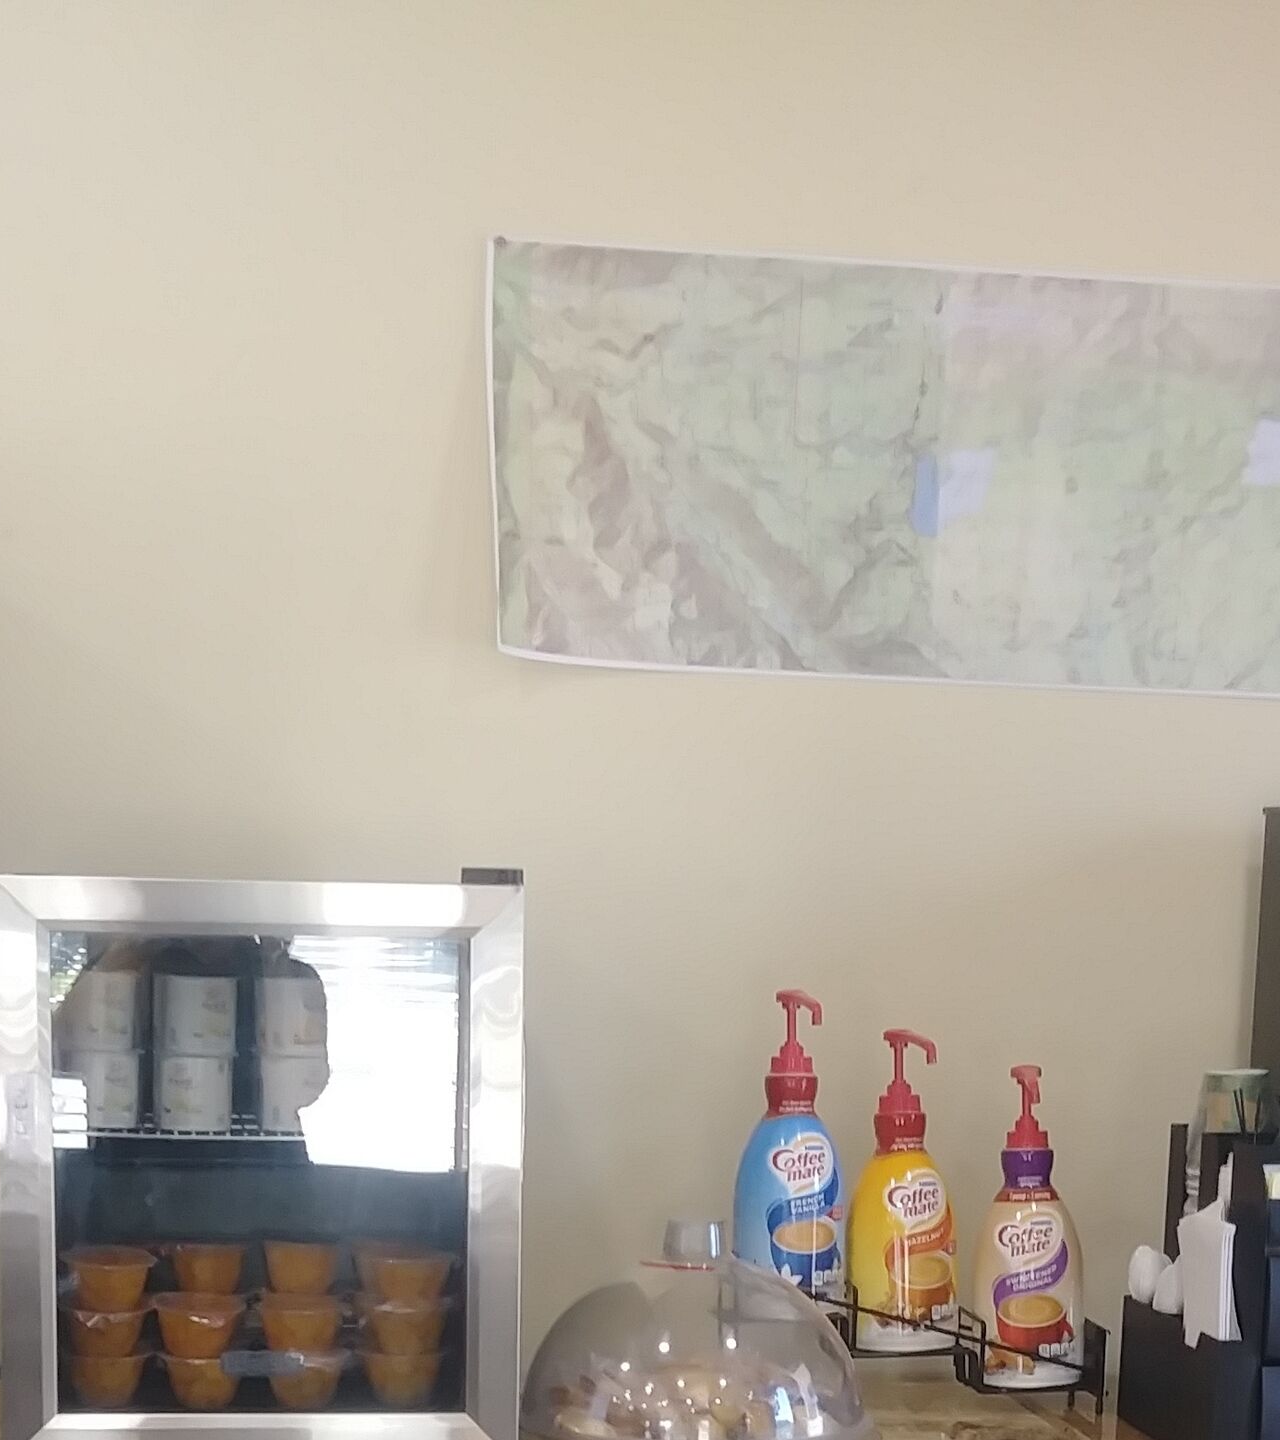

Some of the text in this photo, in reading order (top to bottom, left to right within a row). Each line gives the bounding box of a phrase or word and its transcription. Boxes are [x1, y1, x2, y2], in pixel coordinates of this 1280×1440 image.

[772, 1149, 826, 1172] Coffee
[786, 1164, 825, 1182] mate
[887, 1185, 939, 1208] Coffee
[903, 1200, 939, 1218] mate
[998, 1225, 1053, 1248] Coffee
[1010, 1239, 1051, 1257] mate
